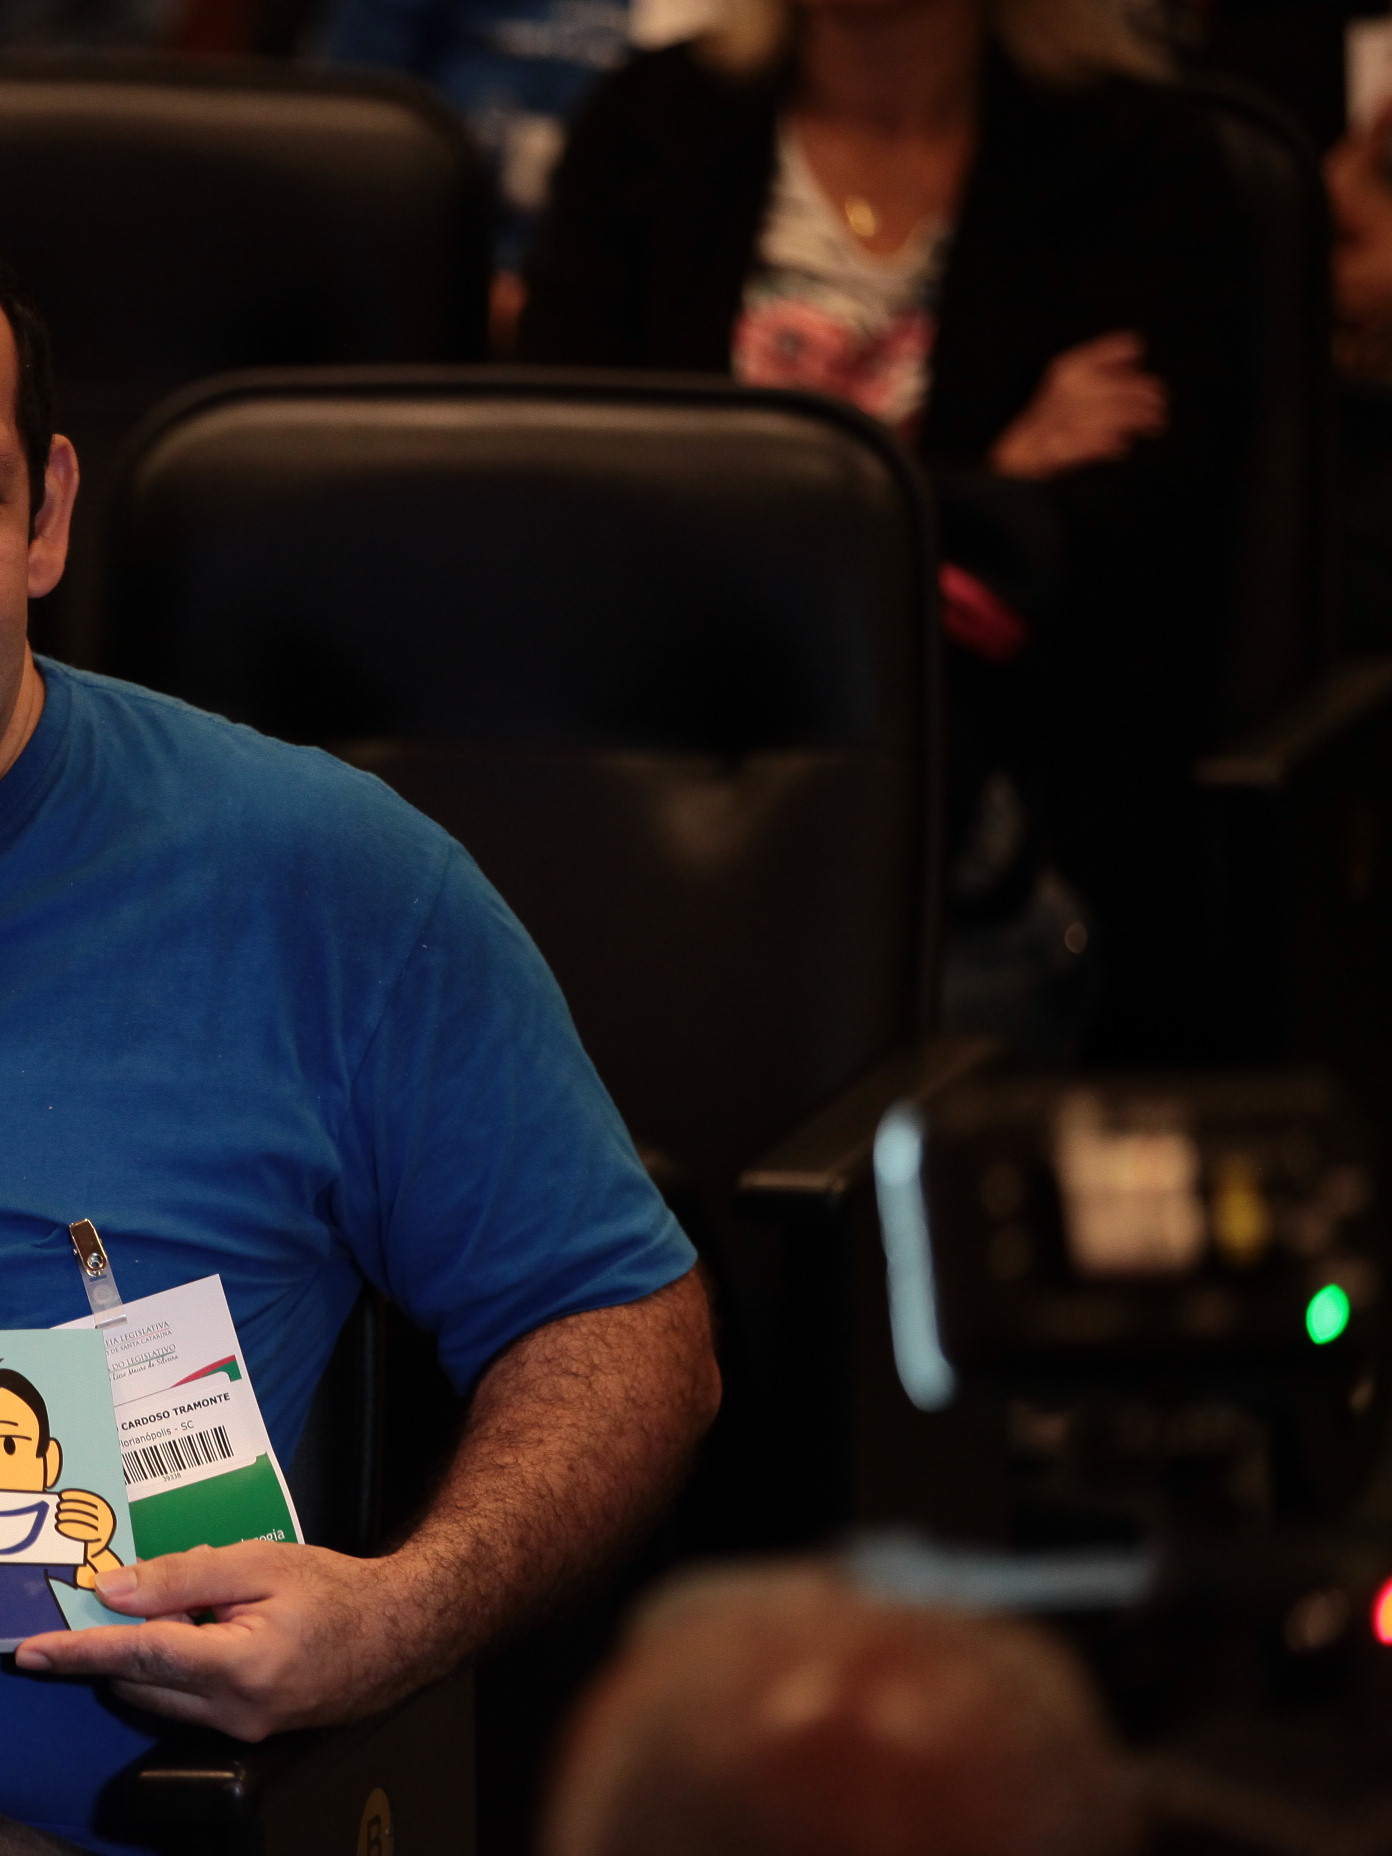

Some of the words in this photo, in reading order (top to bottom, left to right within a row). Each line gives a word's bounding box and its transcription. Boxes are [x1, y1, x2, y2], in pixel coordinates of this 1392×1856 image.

[119, 1321, 170, 1342] LEGISLATIVA
[120, 1340, 140, 1351] SANTA
[140, 1330, 172, 1344] CATARINA
[126, 1343, 177, 1365] LEGISLATIVO
[121, 1410, 170, 1431] CARDOSO
[172, 1392, 231, 1416] TRAMONTE
[119, 1427, 172, 1448] lorianópolis
[180, 1420, 195, 1432] SC
